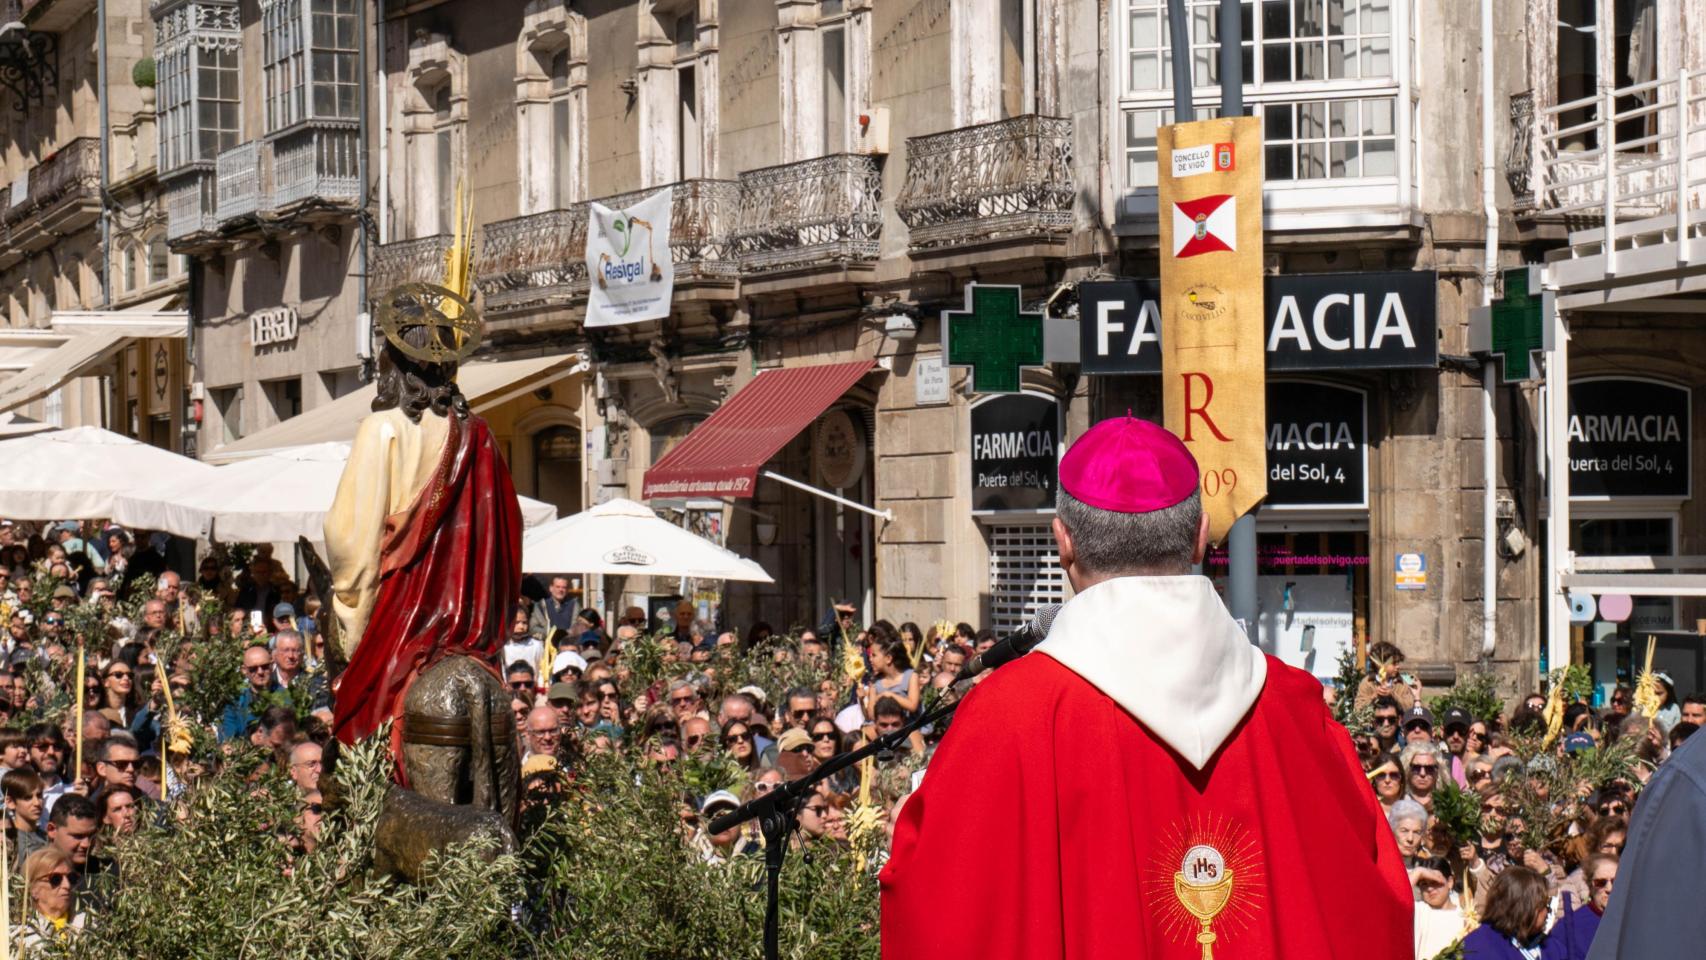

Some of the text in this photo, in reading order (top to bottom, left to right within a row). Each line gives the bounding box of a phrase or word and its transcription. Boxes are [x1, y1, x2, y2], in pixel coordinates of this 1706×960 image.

[1174, 150, 1210, 163] CONCELLO
[1178, 160, 1205, 172] DE VIGO
[605, 255, 644, 282] Resigal
[1097, 292, 1416, 356] FAACIA
[1180, 372, 1234, 442] R
[1265, 421, 1356, 451] MACIA
[1568, 414, 1681, 442] ARMACIA
[974, 430, 1054, 460] FARMACIA
[1270, 463, 1346, 484] del Sol, 4
[1611, 454, 1633, 471] del
[1635, 454, 1661, 475] Sol,
[1665, 459, 1673, 474] 4
[979, 469, 1049, 489] Puerta del Sol, 4
[1204, 468, 1238, 497] 09
[1193, 857, 1217, 879] IHS
